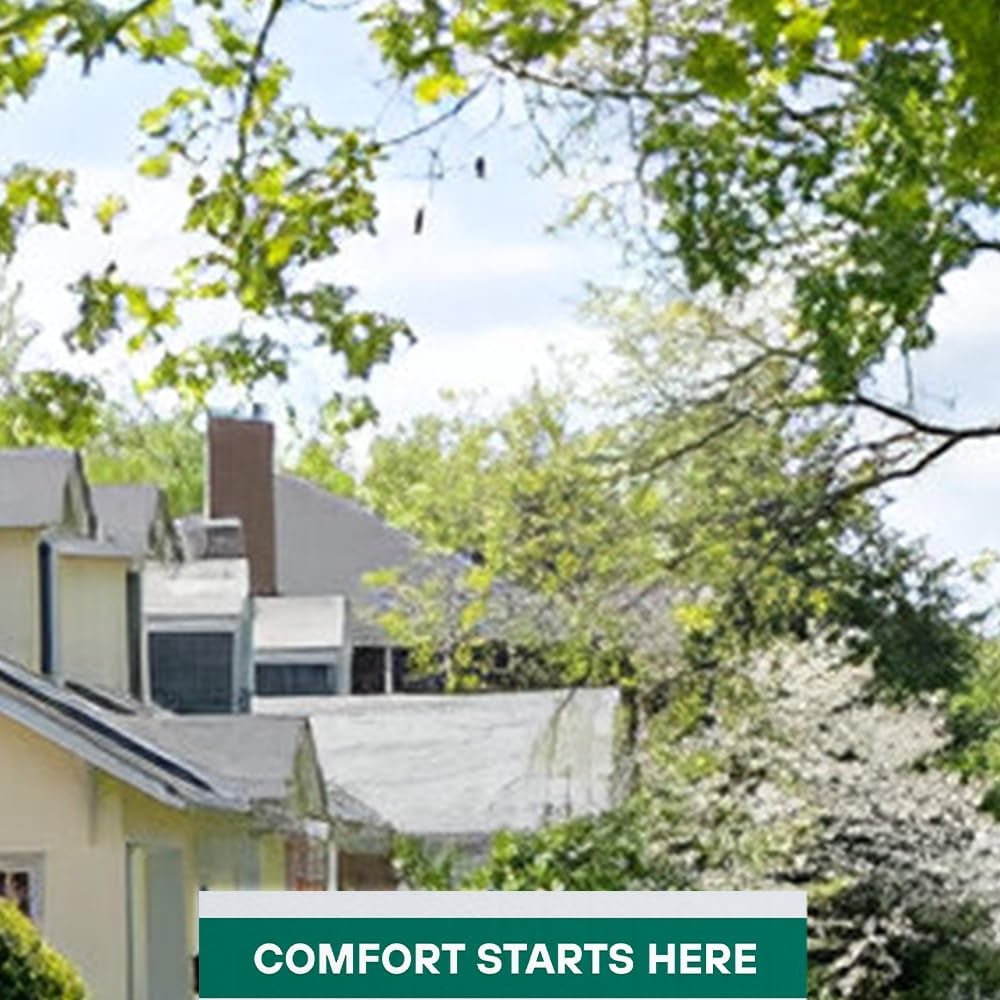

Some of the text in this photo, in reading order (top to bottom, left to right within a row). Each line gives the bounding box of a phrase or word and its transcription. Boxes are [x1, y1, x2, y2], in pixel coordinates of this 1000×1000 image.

[253, 942, 757, 975] COMFORT STARTS HERE
